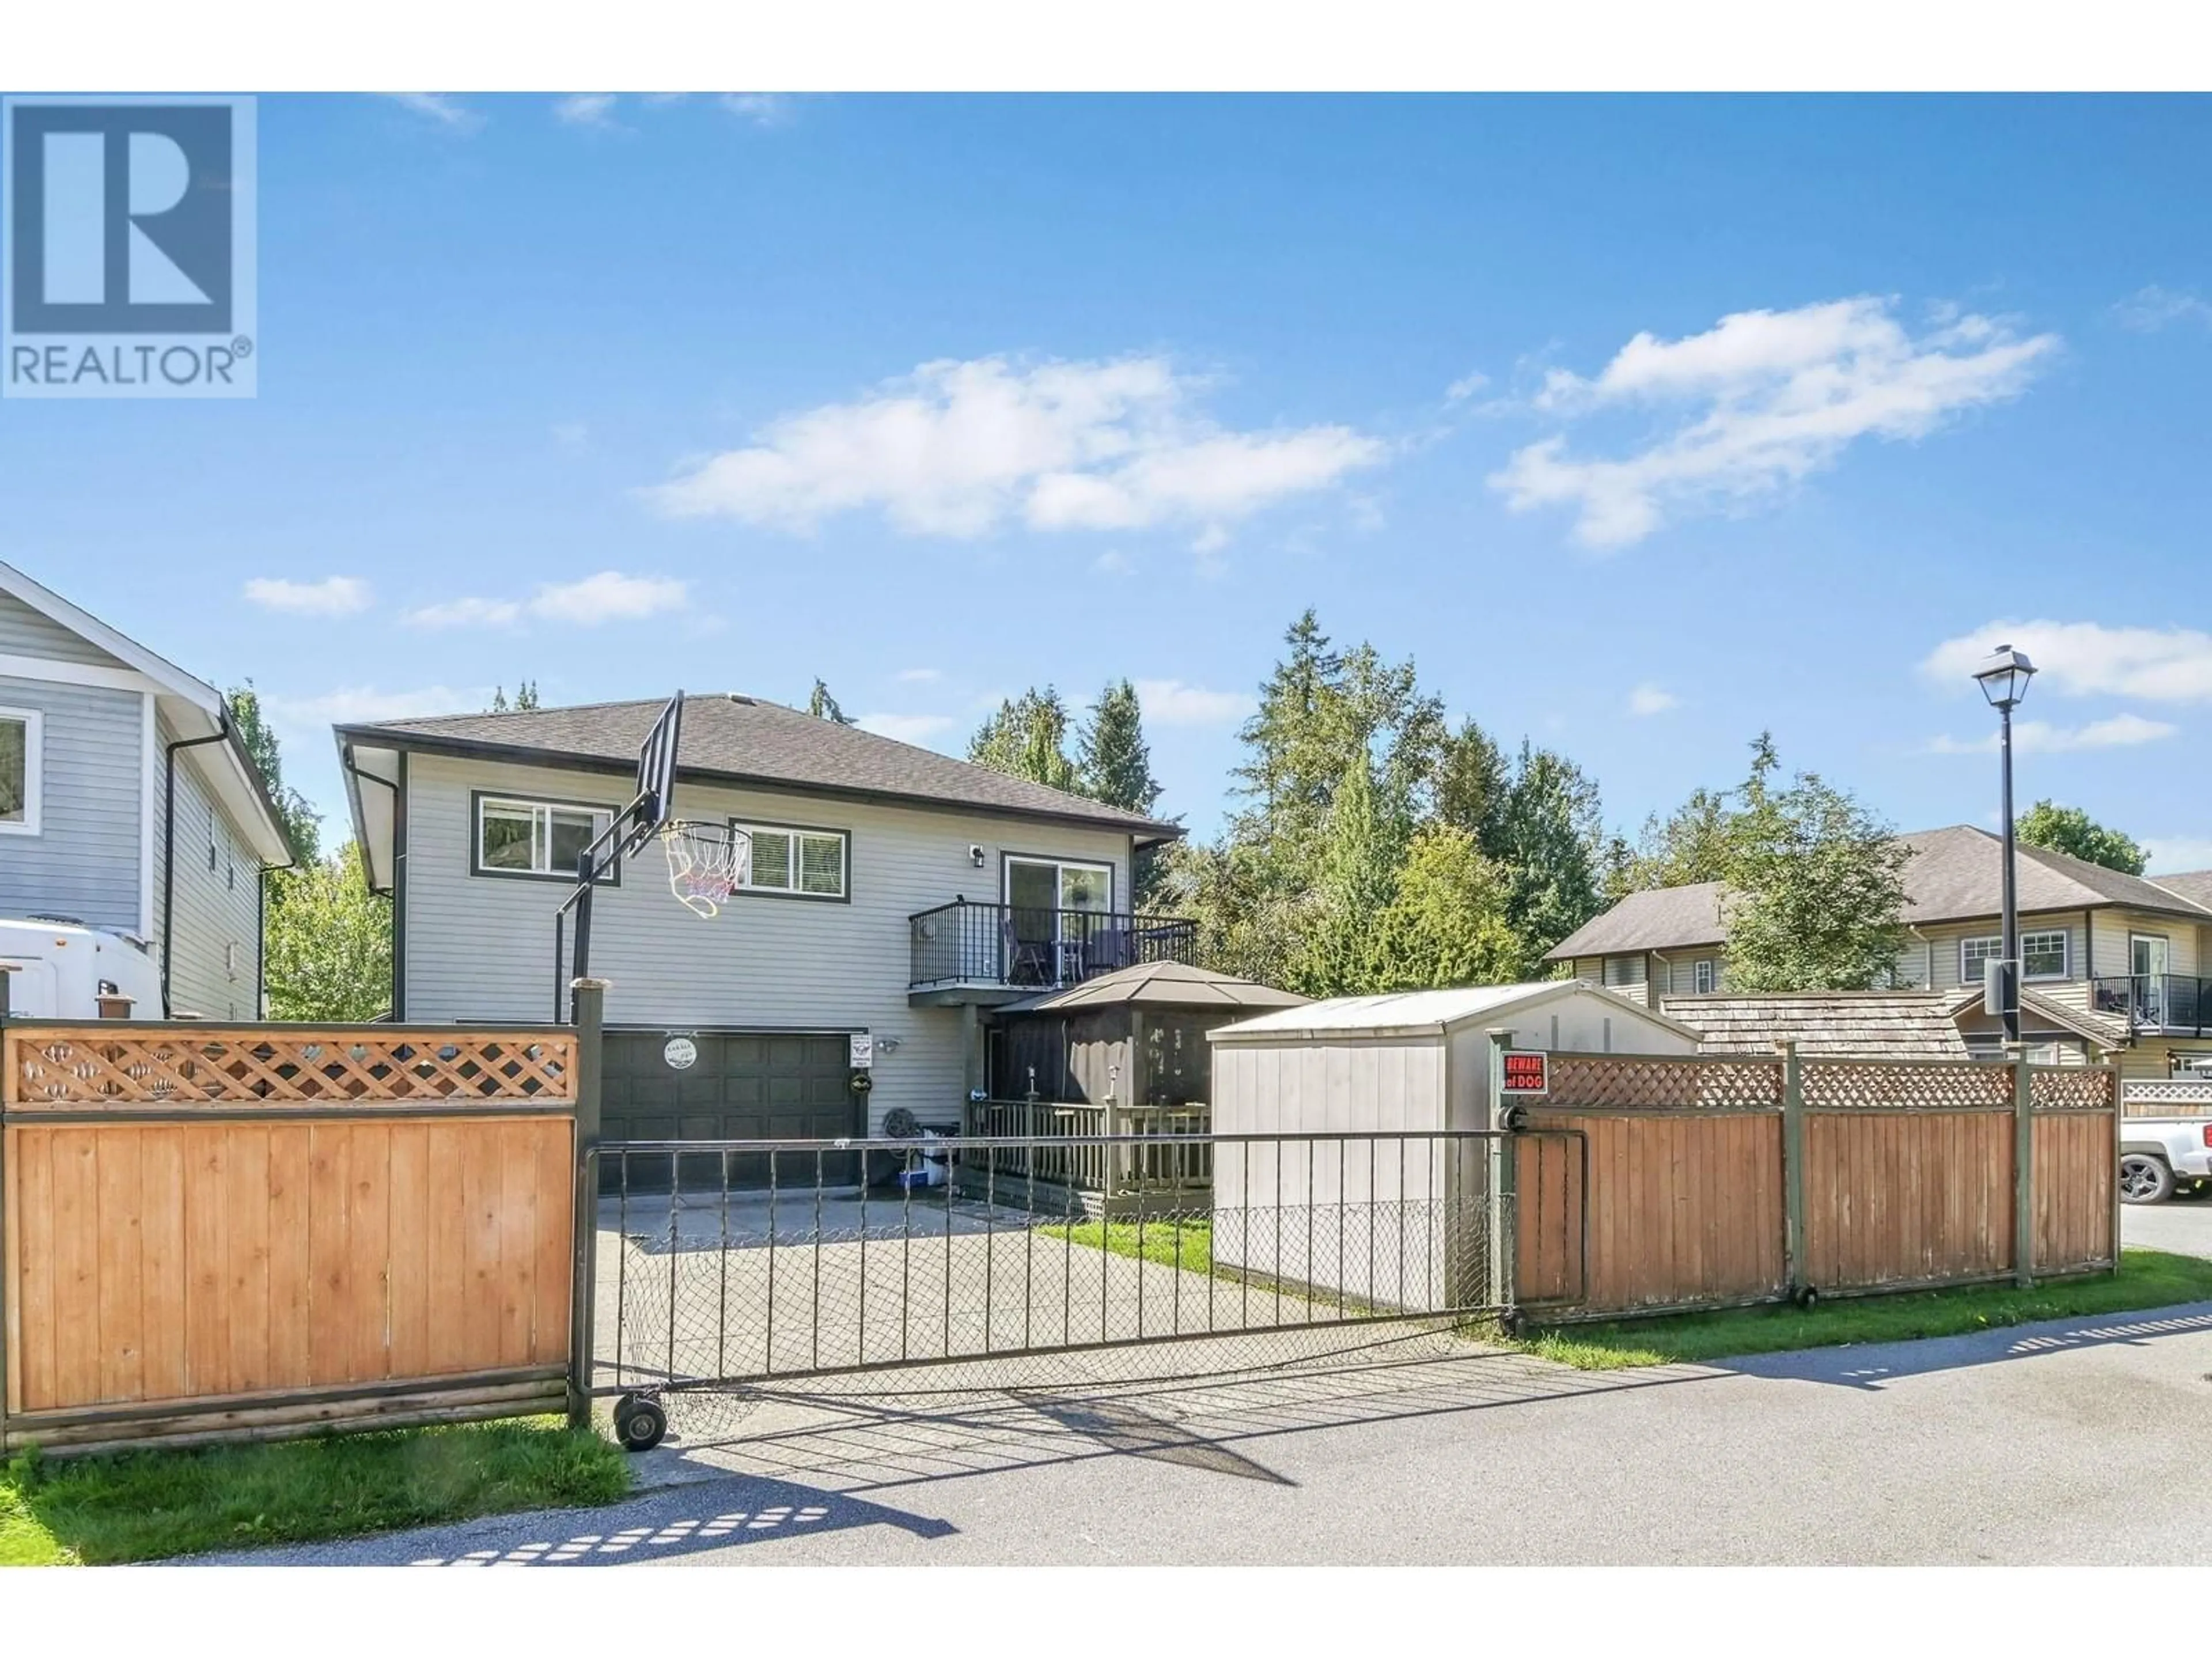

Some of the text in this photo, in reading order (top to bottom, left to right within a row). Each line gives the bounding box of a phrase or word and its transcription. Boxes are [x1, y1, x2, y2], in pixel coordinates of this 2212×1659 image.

[1507, 1058, 1541, 1070] BEWARE
[1507, 1075, 1542, 1088] of DOG
